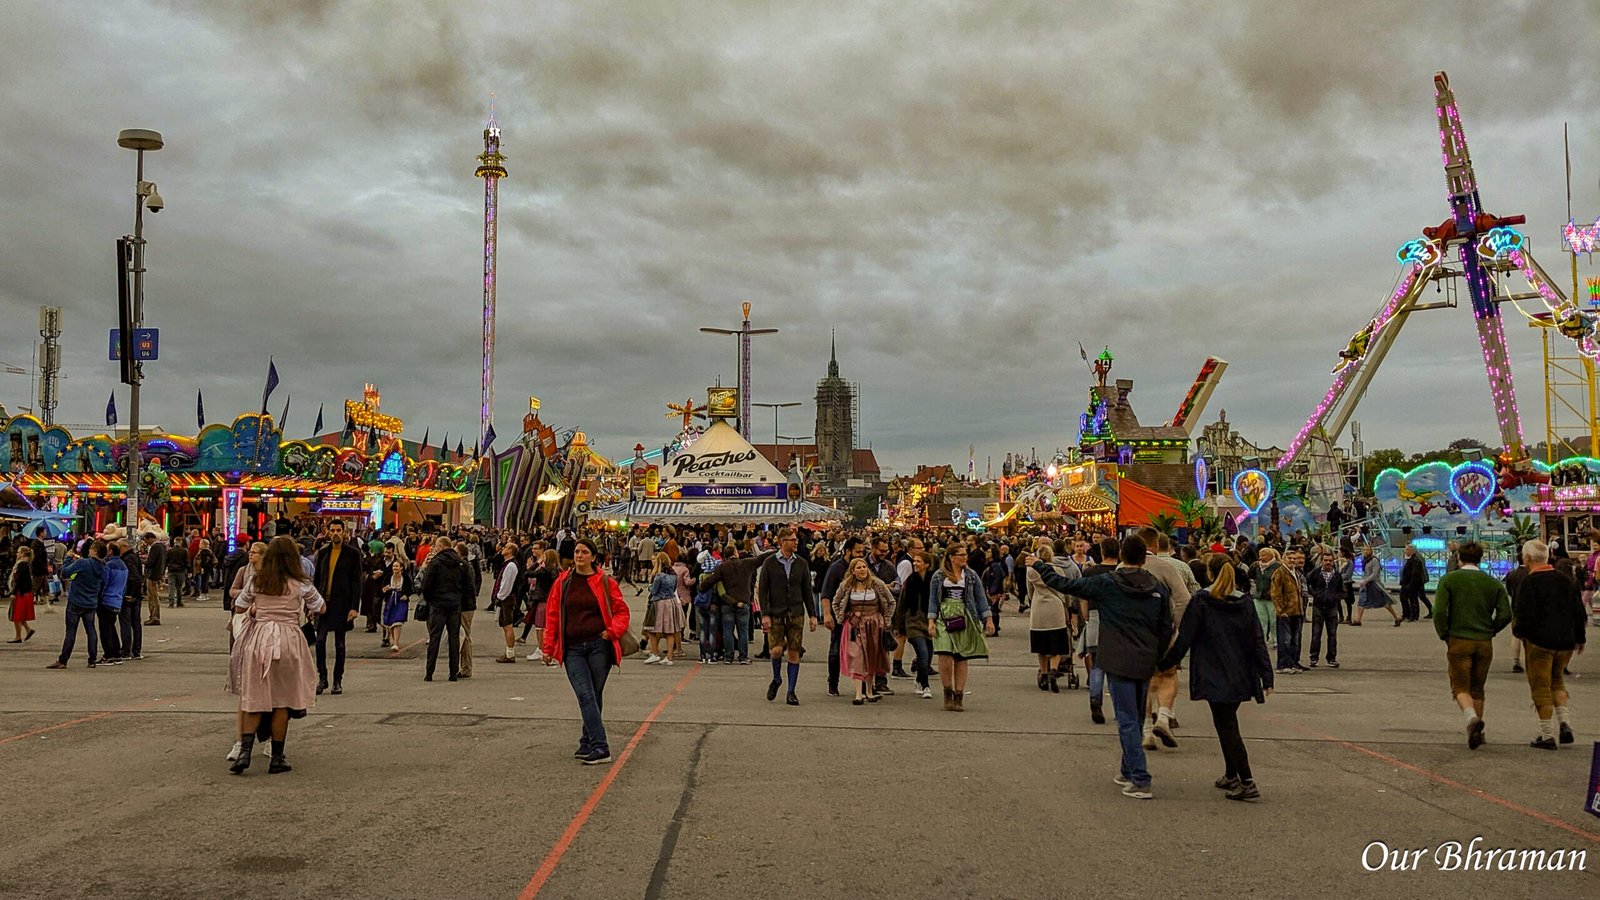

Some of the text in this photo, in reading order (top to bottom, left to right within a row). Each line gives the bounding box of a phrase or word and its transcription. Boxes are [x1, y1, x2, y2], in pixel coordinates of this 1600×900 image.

[710, 389, 737, 404] Peaches
[672, 449, 757, 478] Peaches
[658, 483, 684, 499] Peaches
[705, 487, 752, 495] CAIPIRIÑHA
